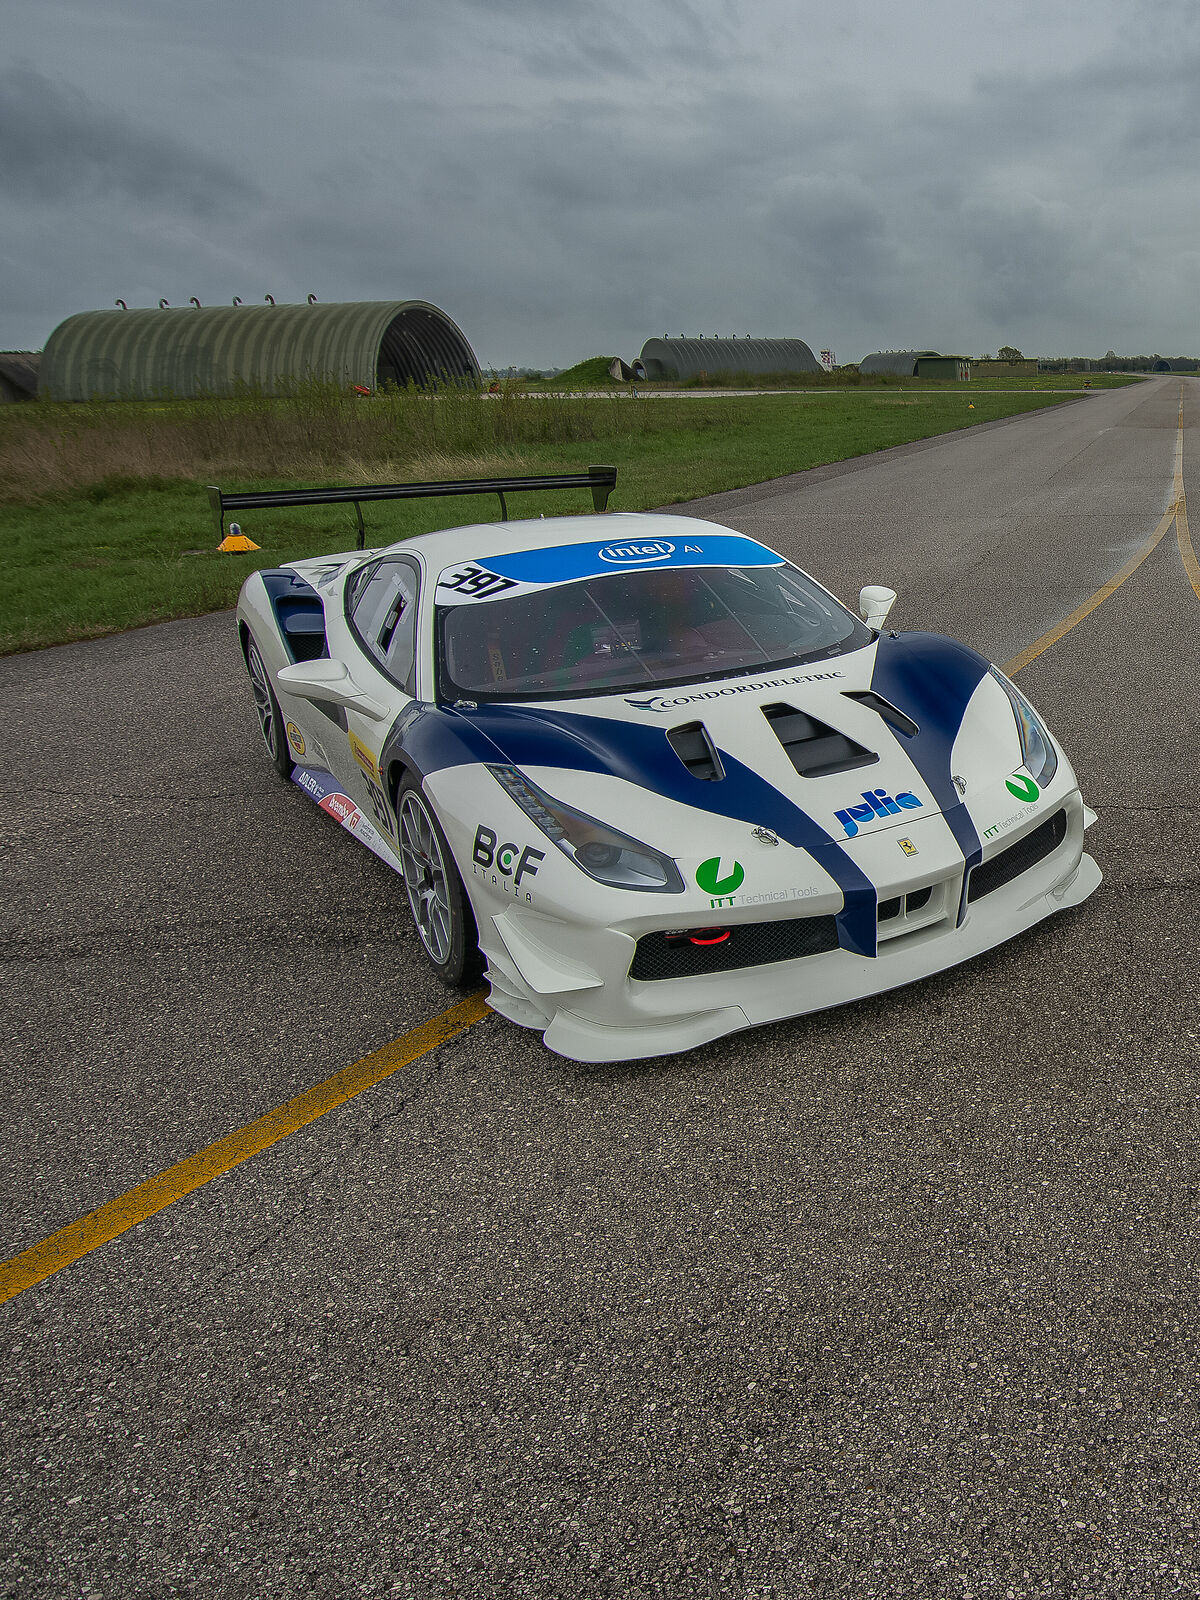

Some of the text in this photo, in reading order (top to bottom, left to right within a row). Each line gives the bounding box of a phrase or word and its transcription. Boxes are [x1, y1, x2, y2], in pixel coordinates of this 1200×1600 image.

[606, 543, 704, 558] intel AI
[438, 567, 520, 600] 397
[660, 671, 847, 708] CONDORDIELETRIC
[298, 771, 318, 793] ADLER
[327, 794, 350, 820] brembo
[833, 787, 924, 837] julia
[983, 803, 1040, 840] ITT Technical Tools
[472, 824, 547, 887] BCF
[472, 863, 532, 904] ITALIA
[710, 886, 820, 909] ITT Technical Tools
